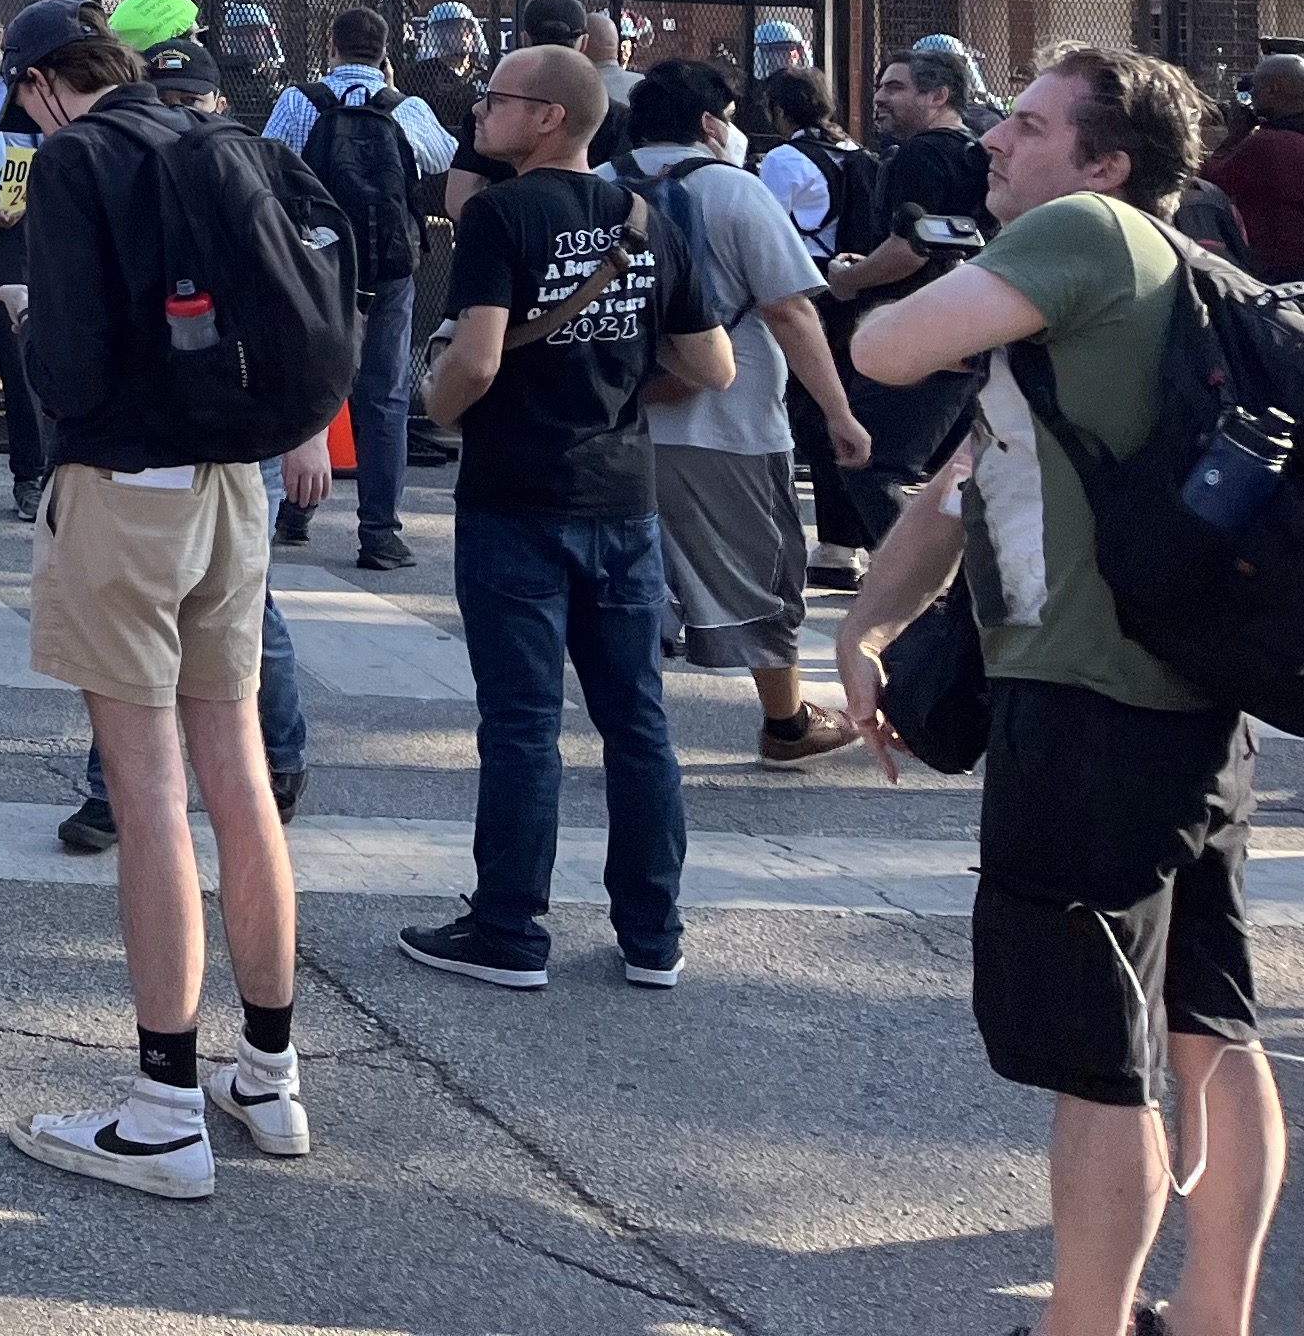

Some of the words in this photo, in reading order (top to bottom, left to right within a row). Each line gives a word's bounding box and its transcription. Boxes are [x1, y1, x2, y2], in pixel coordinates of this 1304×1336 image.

[545, 264, 561, 281] A
[627, 273, 655, 290] For
[605, 296, 646, 314] Years
[547, 313, 638, 344] 2021
